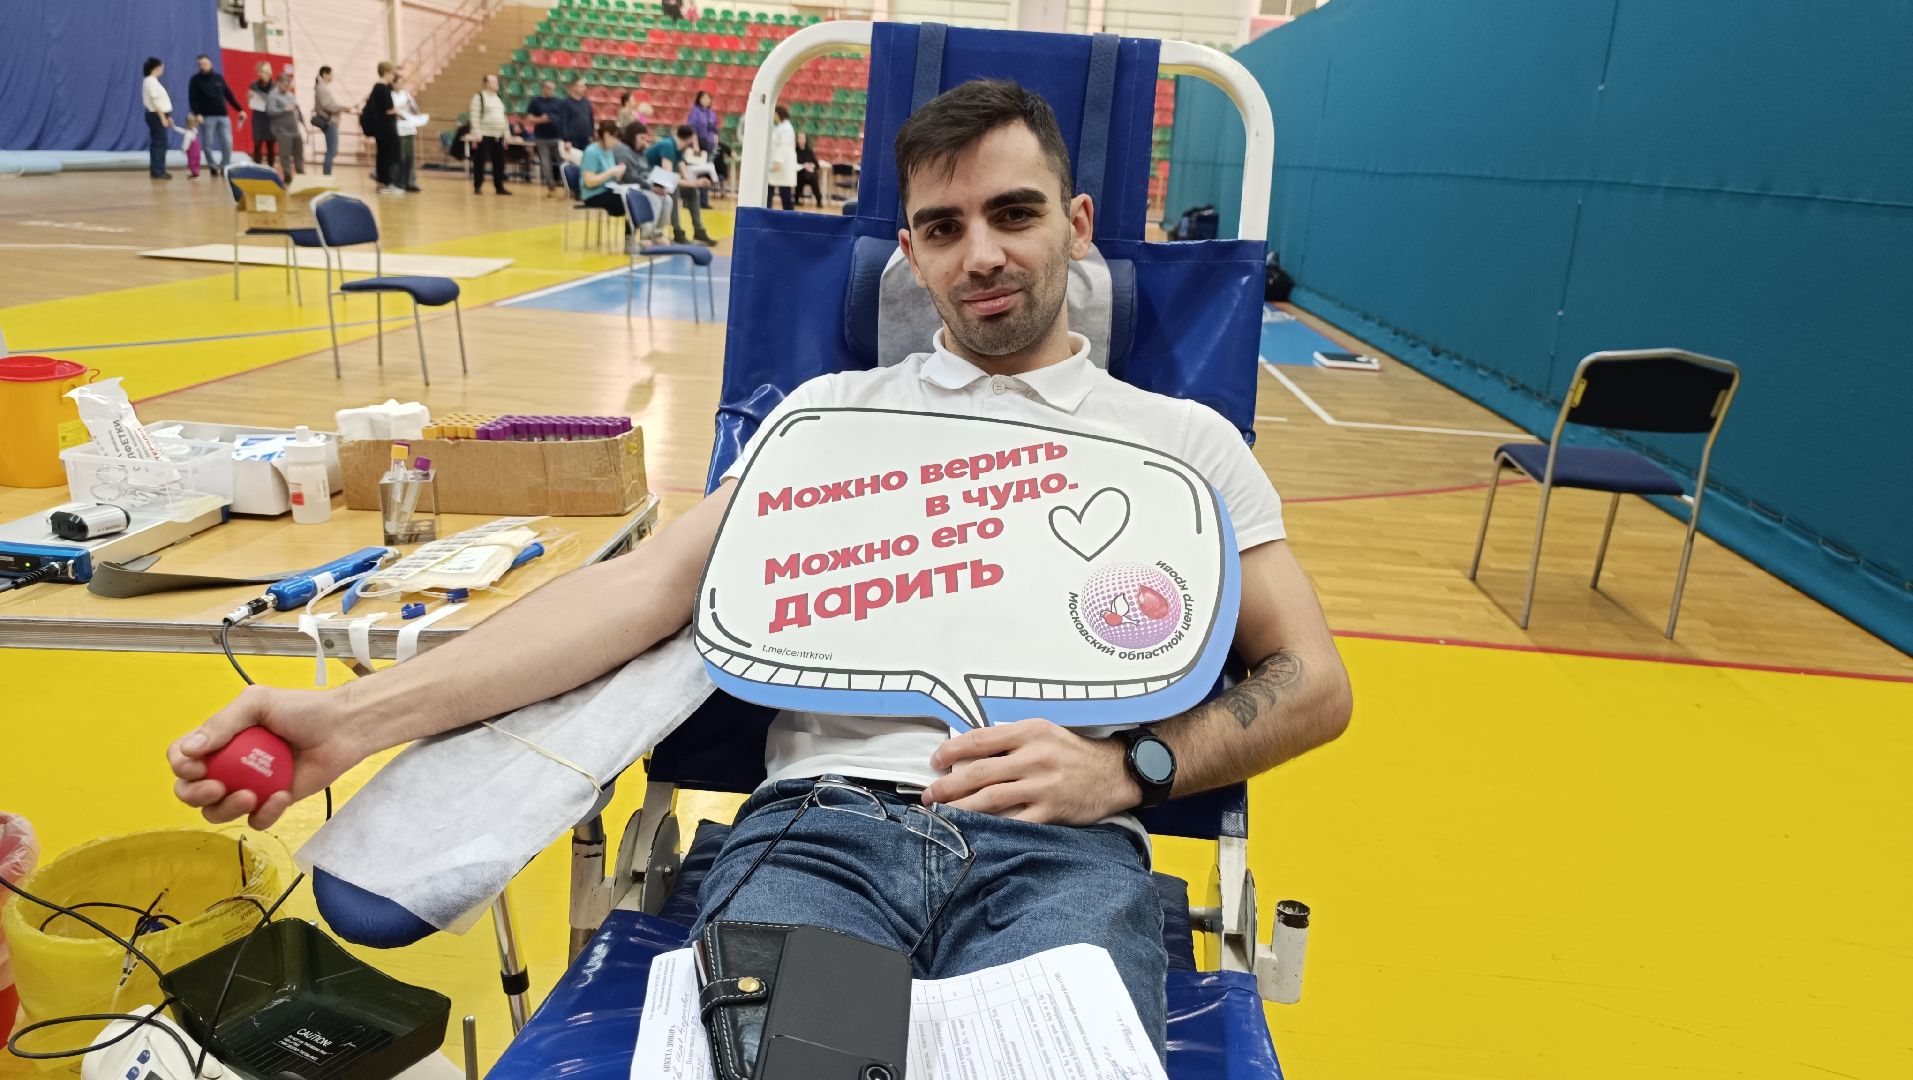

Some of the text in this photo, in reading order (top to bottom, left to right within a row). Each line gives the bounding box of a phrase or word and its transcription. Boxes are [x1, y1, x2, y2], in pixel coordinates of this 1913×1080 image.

[757, 441, 1068, 517] Можно верить
[925, 472, 1079, 518] в чудо.
[764, 517, 1005, 586] Можно его
[768, 558, 1005, 635] дарить
[1068, 560, 1195, 661] Московский областной центр крови
[762, 644, 833, 661] t.me/centrkrovi
